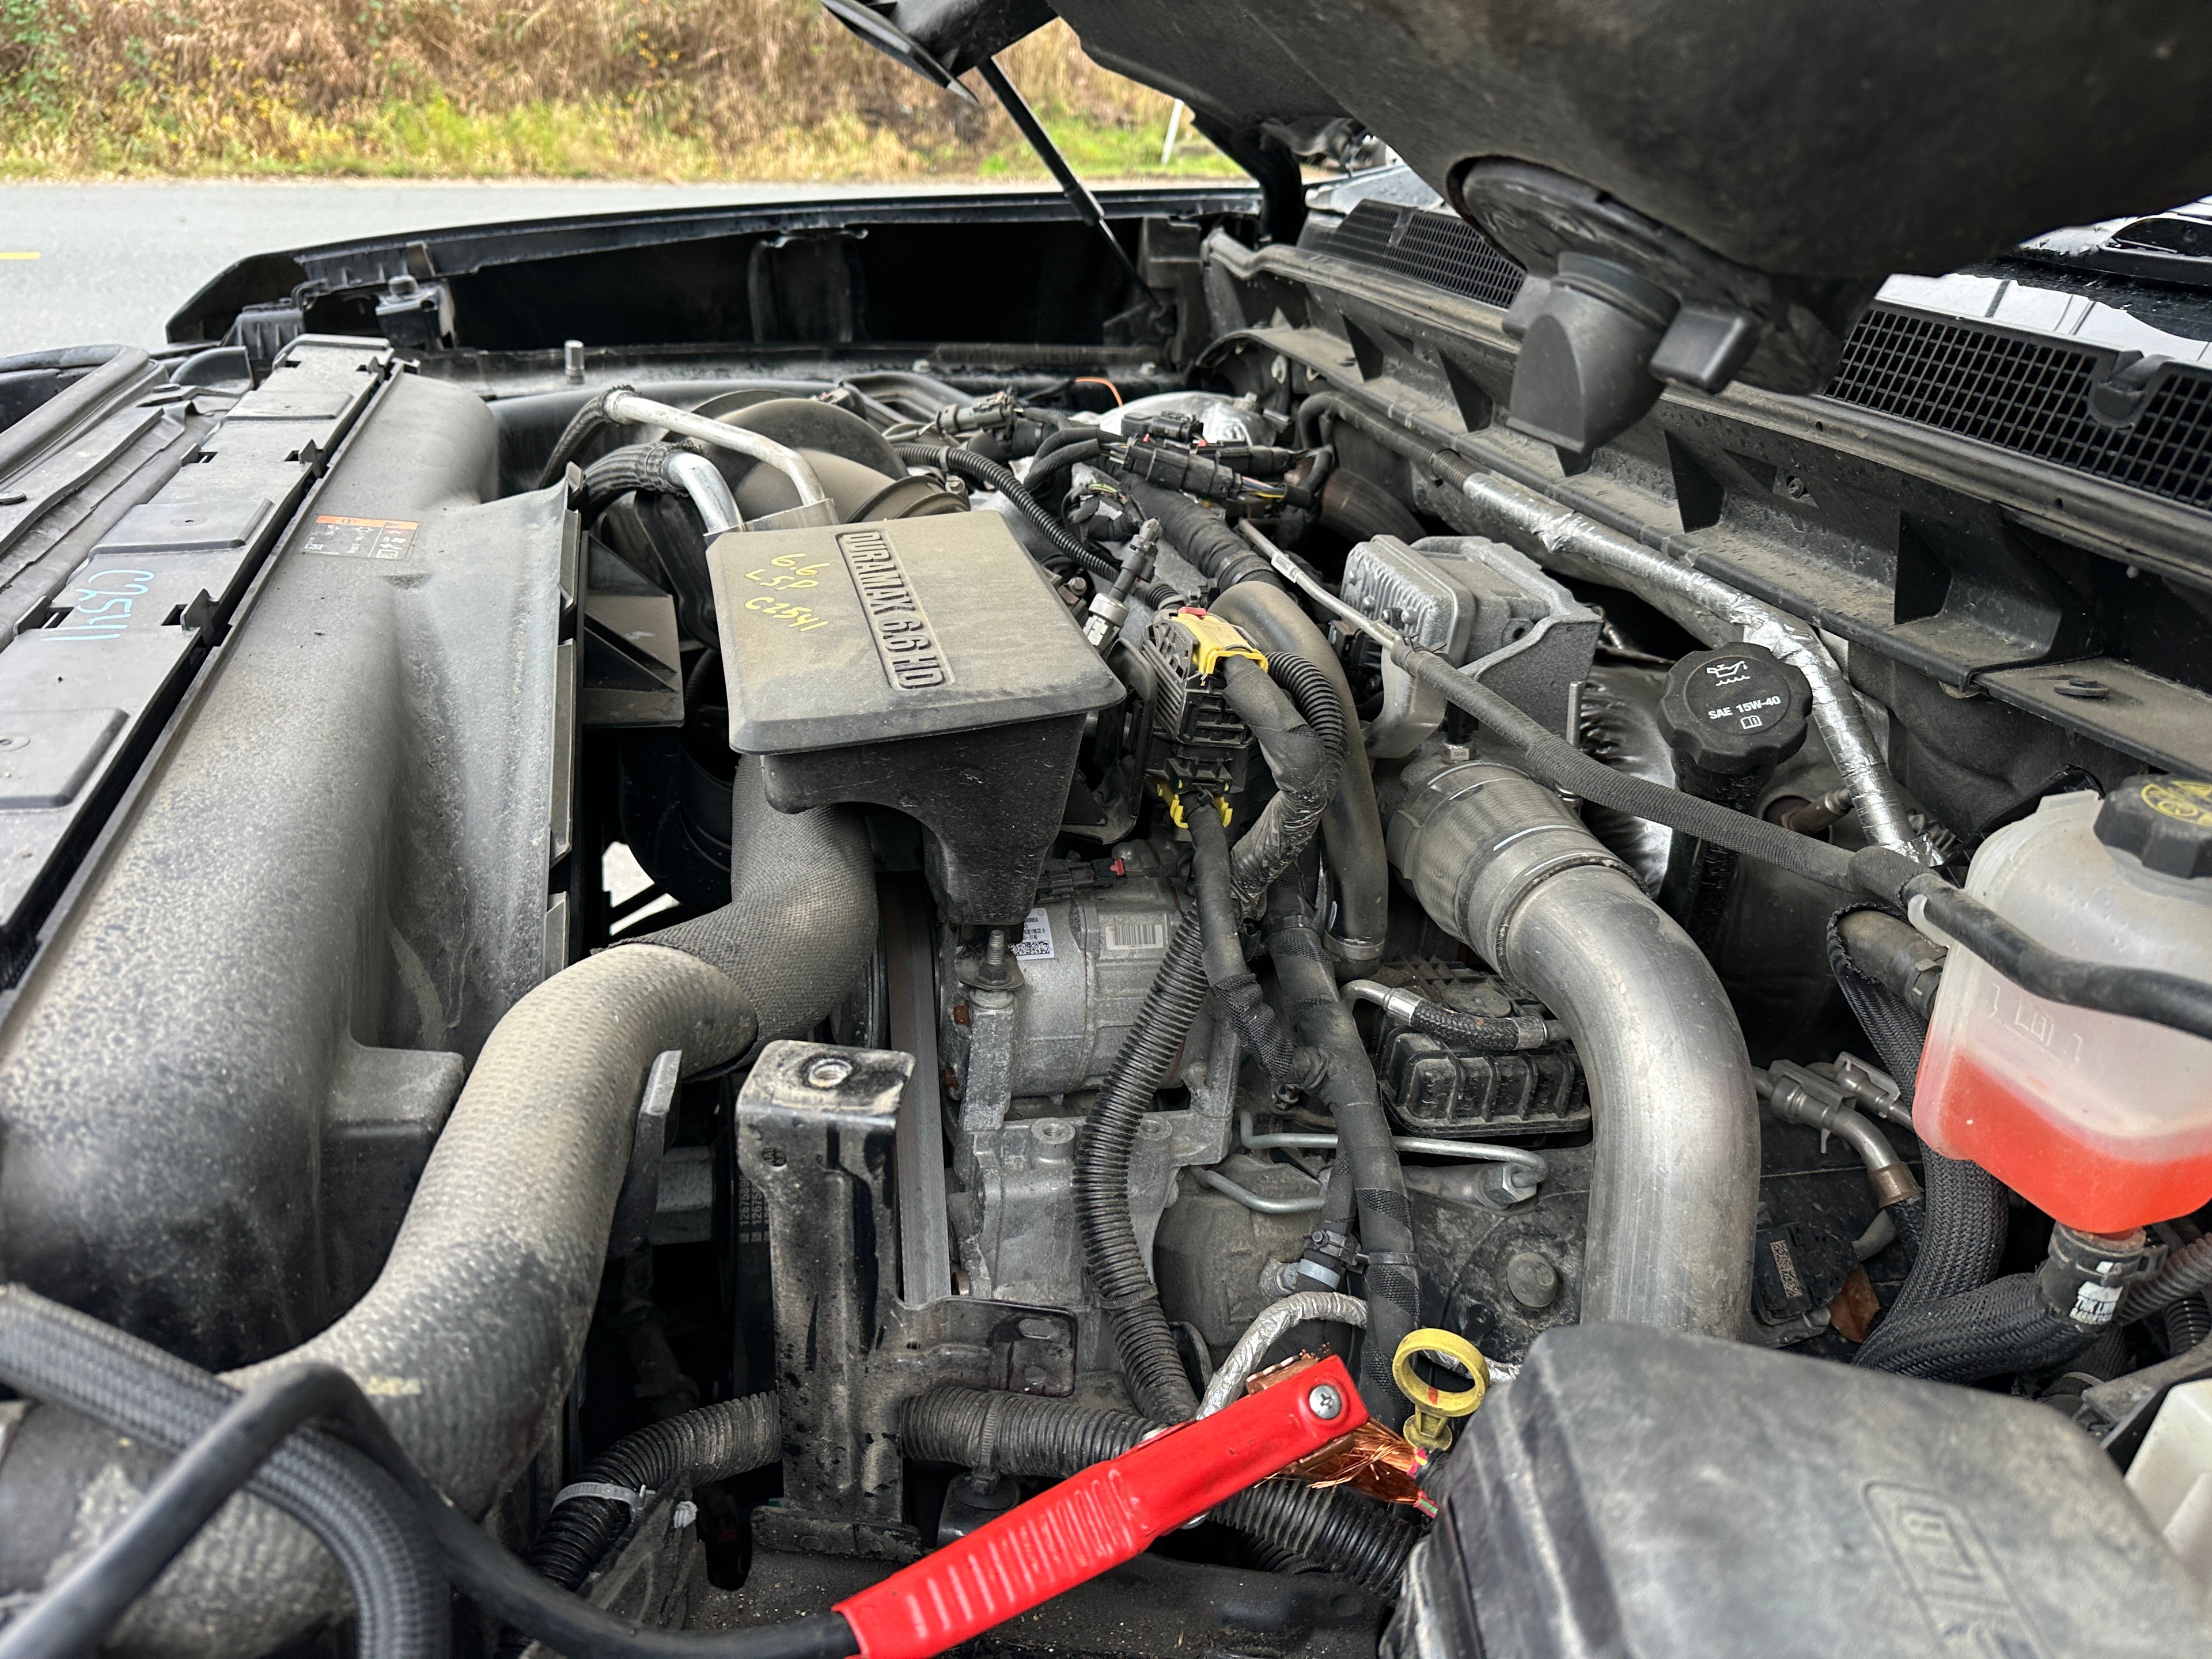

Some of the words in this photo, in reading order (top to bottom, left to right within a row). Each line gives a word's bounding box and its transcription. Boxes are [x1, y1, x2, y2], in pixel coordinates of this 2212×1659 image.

[771, 553, 831, 575] 6.6
[842, 532, 915, 615] DURAMAX
[744, 597, 830, 632] C2541
[878, 617, 932, 652] 6.6
[891, 654, 945, 689] HD
[1708, 707, 1733, 719] SAE
[1736, 696, 1781, 713] 15W-40
